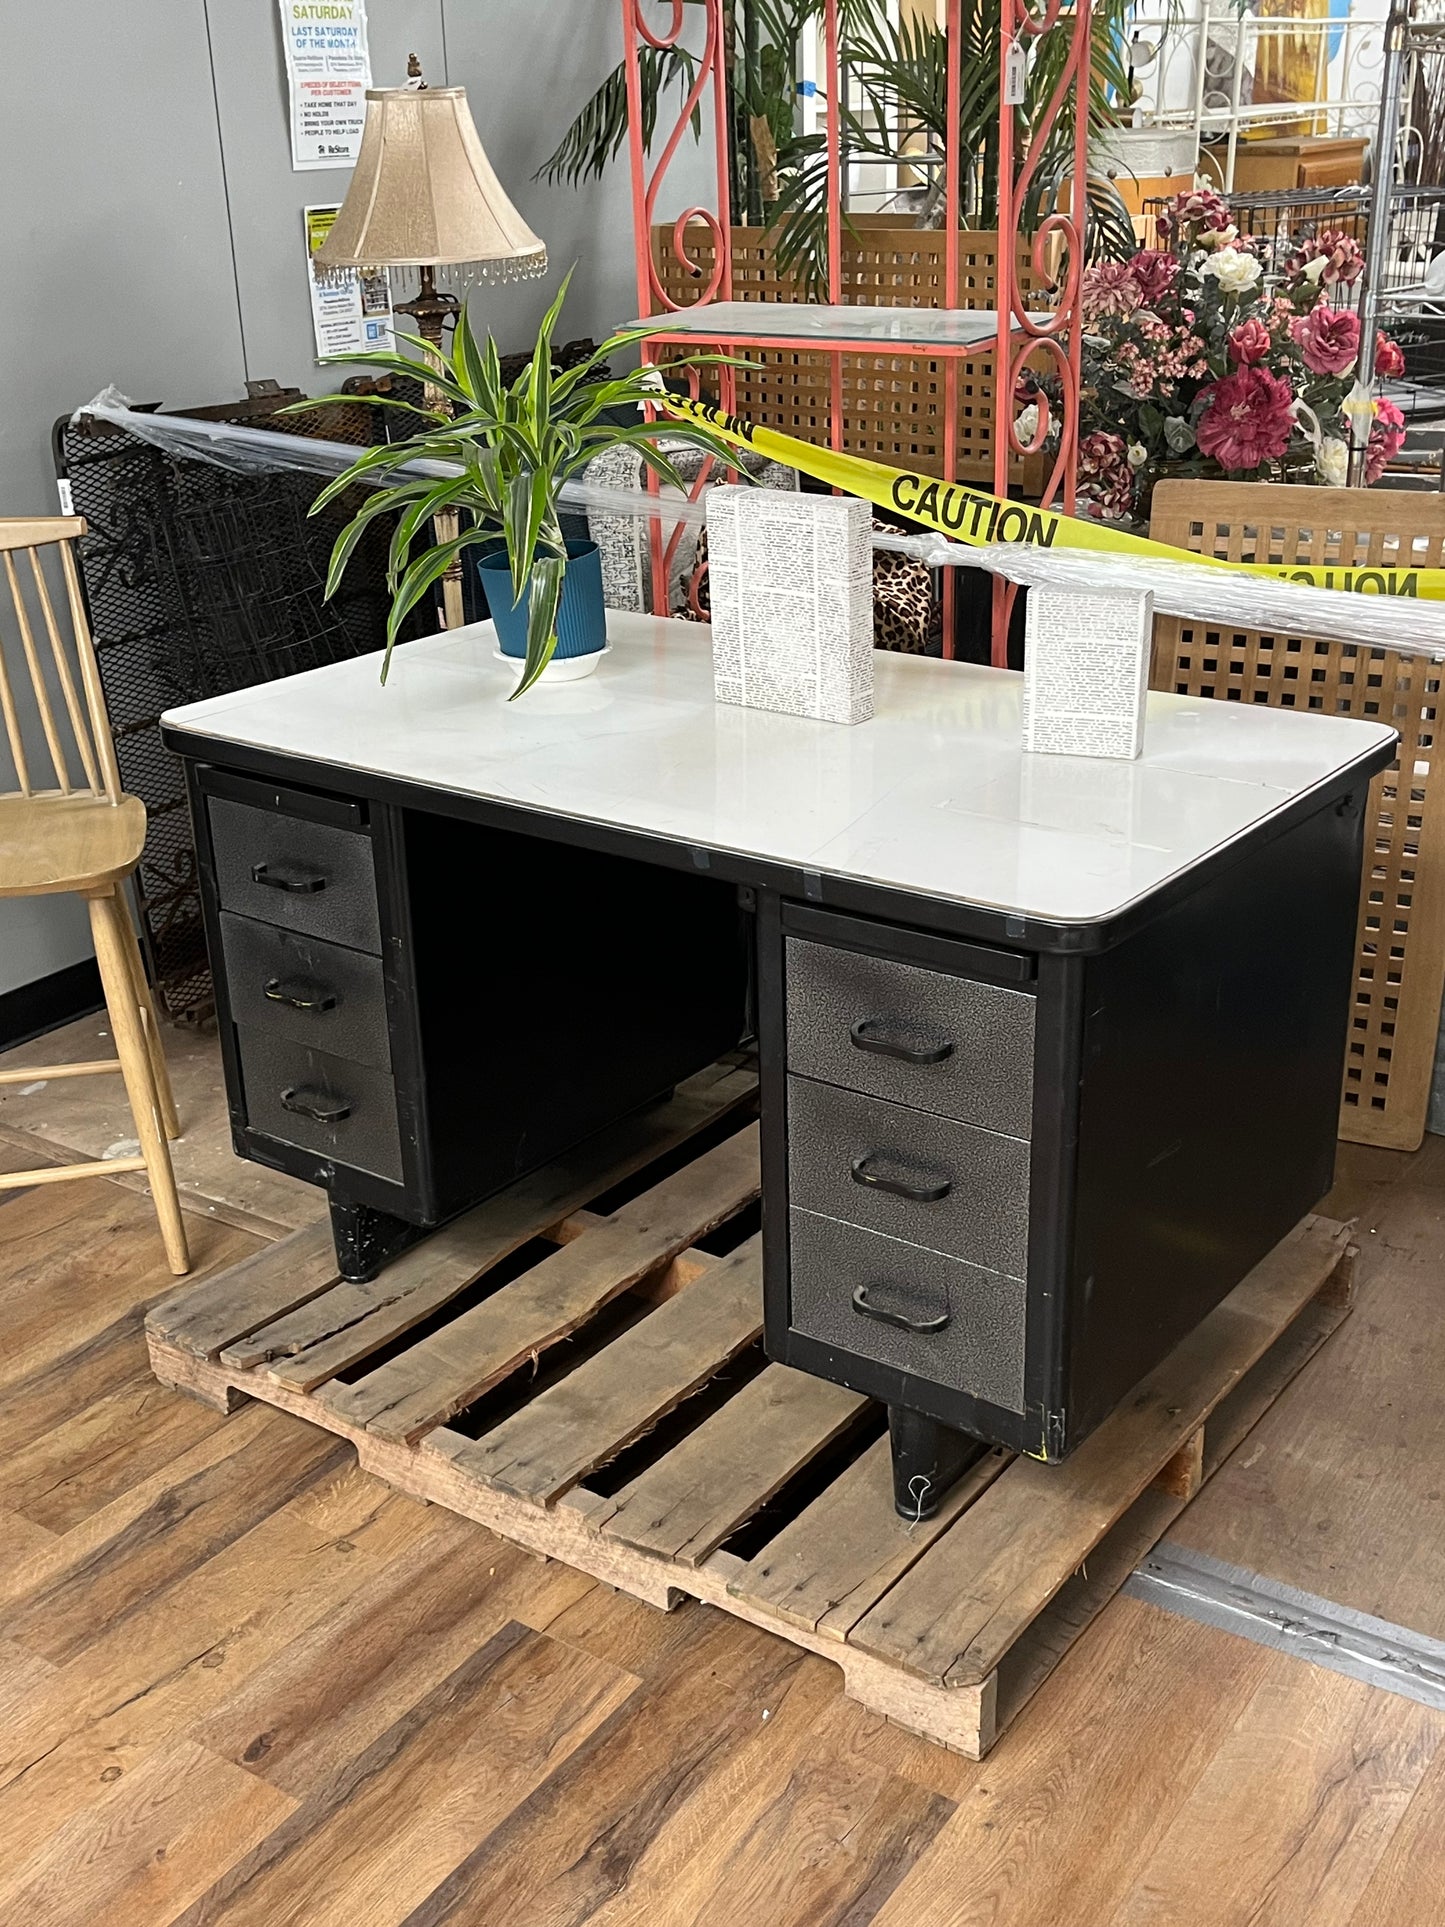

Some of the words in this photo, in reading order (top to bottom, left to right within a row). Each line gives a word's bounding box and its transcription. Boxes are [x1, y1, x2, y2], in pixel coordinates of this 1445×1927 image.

[293, 5, 353, 20] SATURDAY
[292, 27, 313, 36] LAST
[315, 27, 358, 36] SATURDAY
[296, 39, 309, 48] OF
[310, 39, 325, 48] THE
[328, 39, 357, 48] MONTH
[892, 474, 1059, 548] CAUTION
